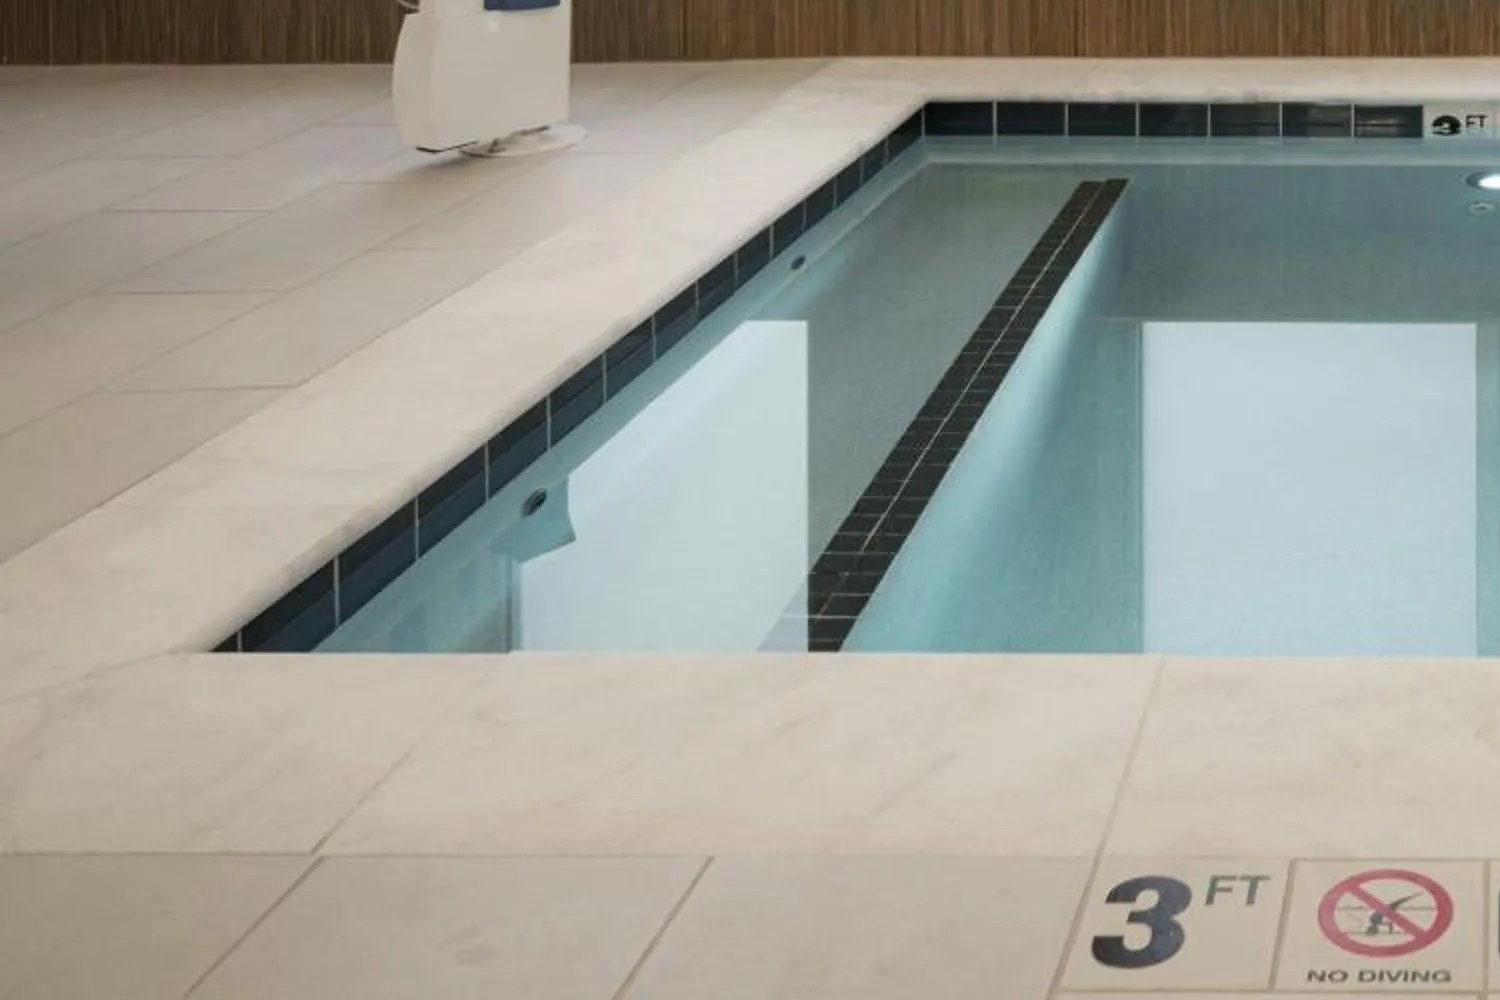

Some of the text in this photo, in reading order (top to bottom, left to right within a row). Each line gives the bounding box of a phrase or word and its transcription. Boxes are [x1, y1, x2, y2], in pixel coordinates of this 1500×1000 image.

[1465, 114, 1489, 130] FT
[1091, 875, 1271, 969] 3 FT
[1306, 969, 1452, 983] NO DIVING
